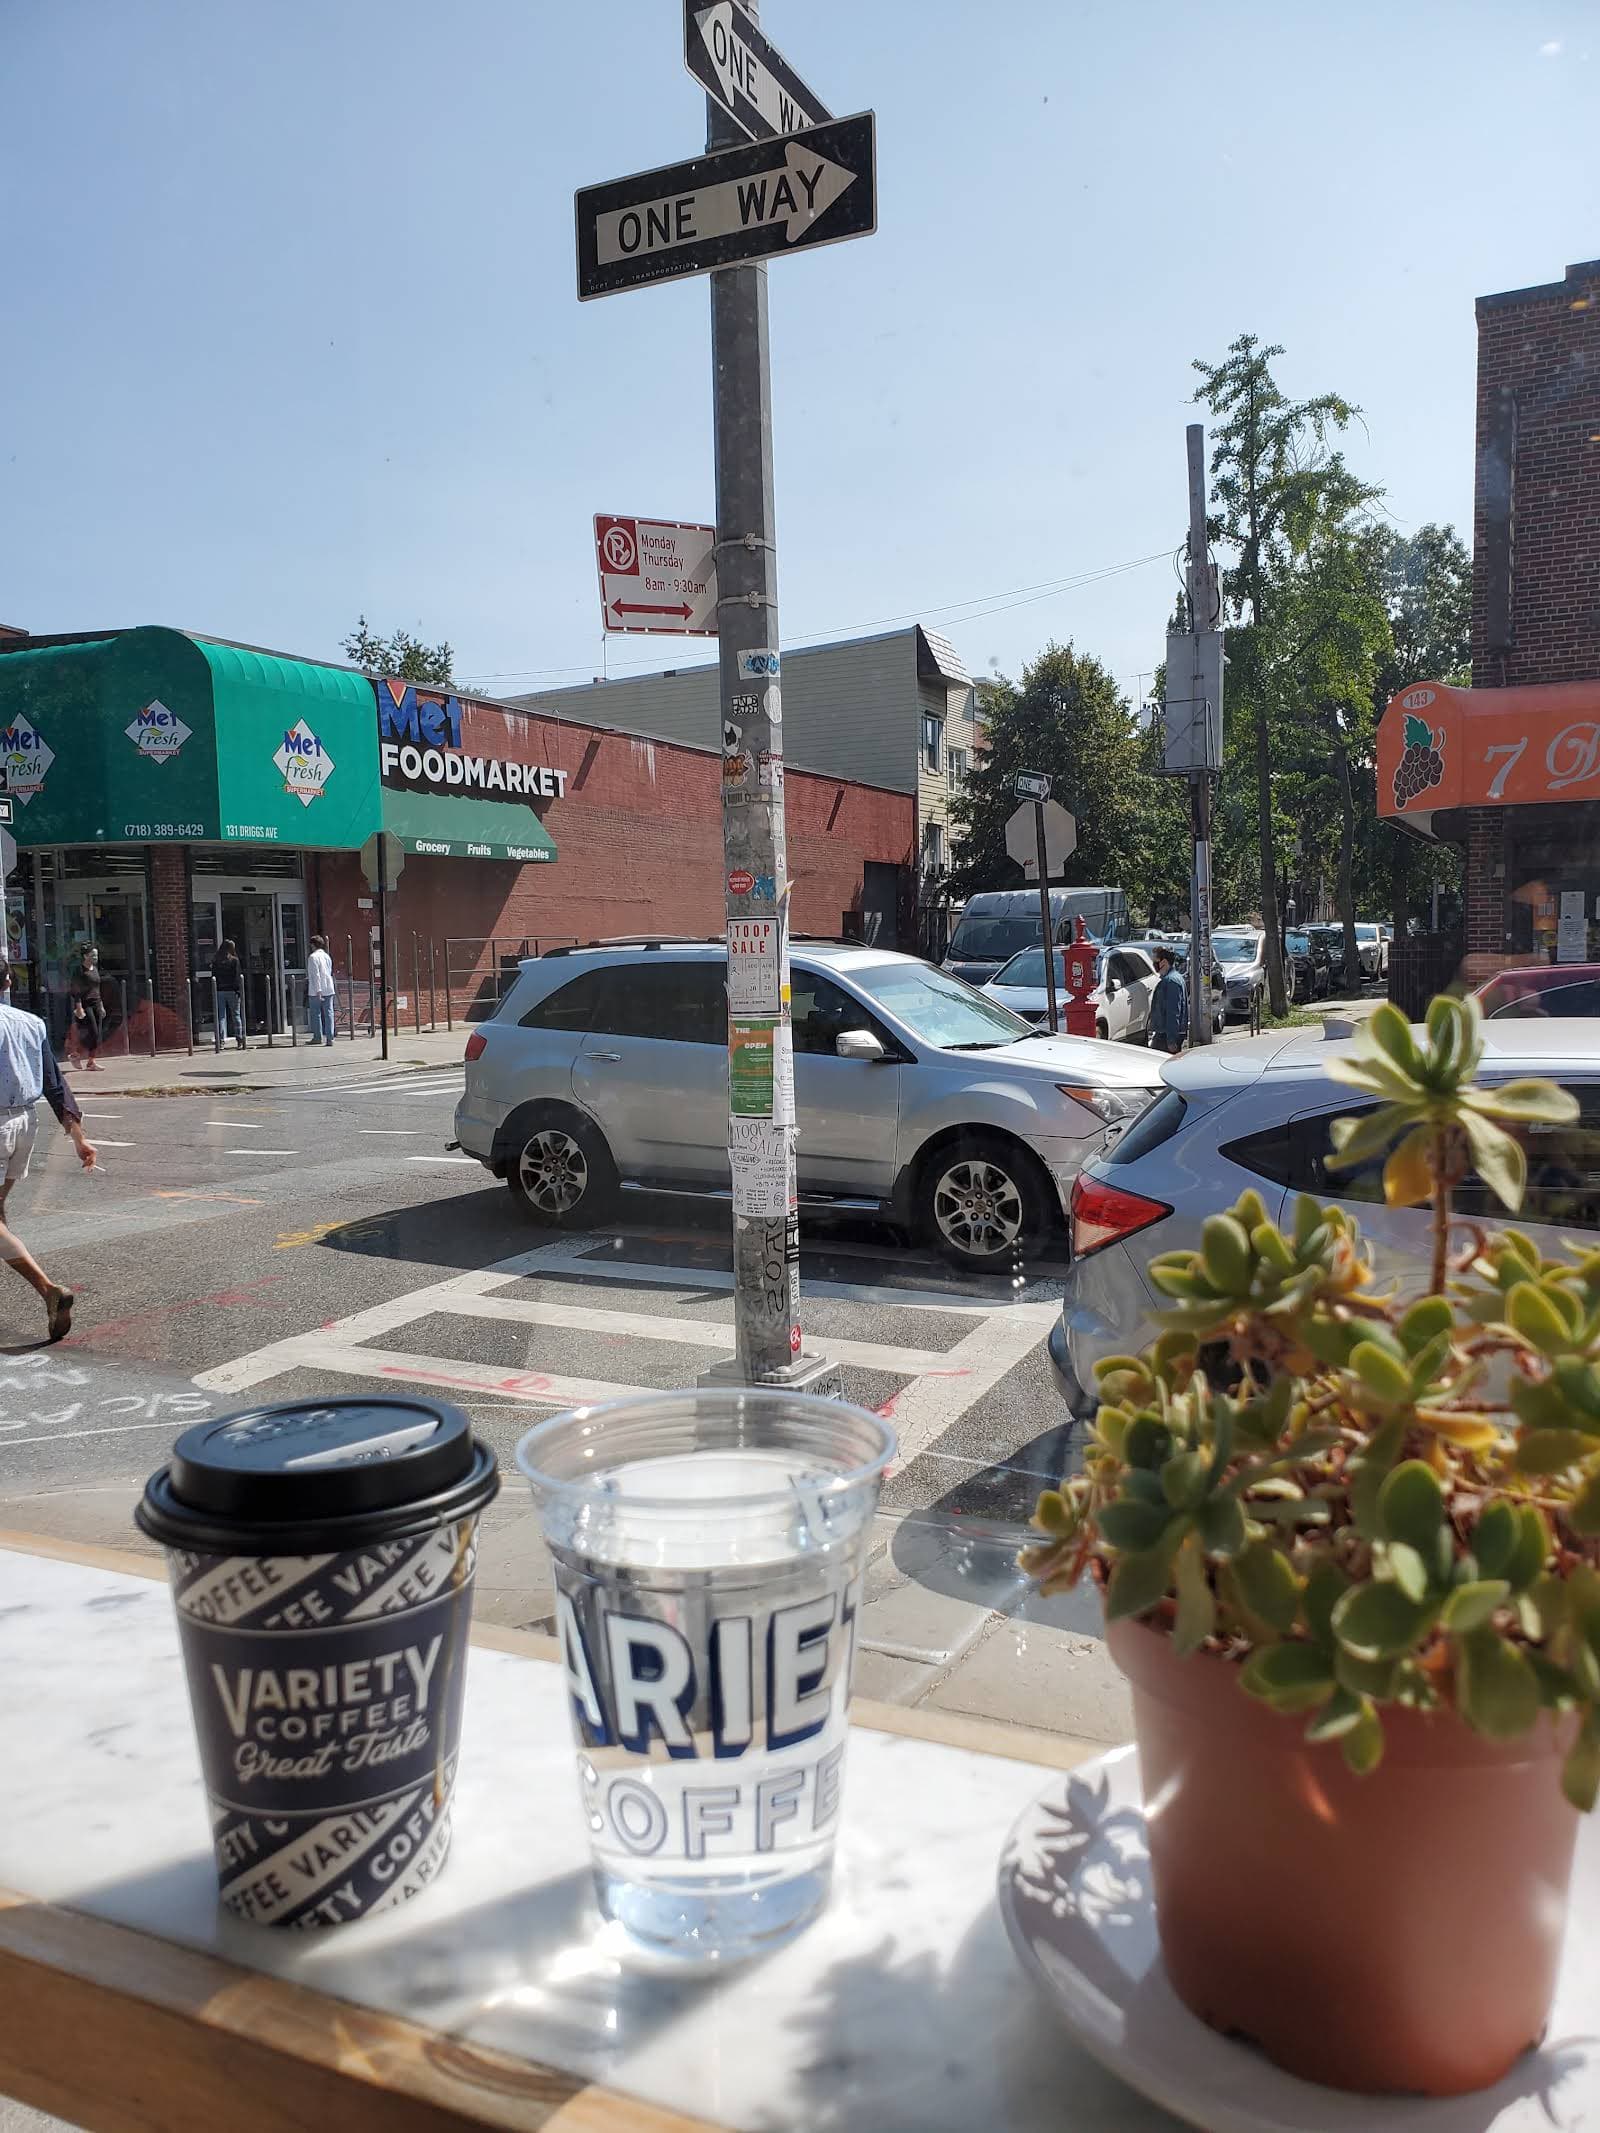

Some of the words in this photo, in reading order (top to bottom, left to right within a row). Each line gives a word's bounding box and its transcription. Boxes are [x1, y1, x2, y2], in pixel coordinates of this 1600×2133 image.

[713, 19, 758, 105] ONE
[618, 196, 698, 254] ONE
[737, 164, 826, 226] WAY
[641, 534, 676, 553] Monday
[643, 551, 685, 571] Thursday
[645, 576, 666, 591] 8am
[674, 579, 707, 595] 9:30am
[137, 707, 178, 726] Met
[377, 679, 464, 749] Met
[2, 727, 40, 753] Met
[137, 727, 179, 746] fresh
[284, 730, 322, 758] Met
[284, 755, 324, 785] fresh
[381, 742, 567, 799] FOODMARKET
[1484, 736, 1529, 799] 7
[286, 786, 324, 796] SUPERMARKET
[1019, 777, 1033, 791] ONE
[125, 824, 152, 837] (718)
[154, 824, 204, 837] 389-6429
[226, 825, 238, 837] 131
[240, 825, 264, 838] DRIGGS
[265, 827, 278, 839] AVE
[415, 840, 451, 856] Grocery
[467, 844, 492, 857] Fruits
[506, 846, 550, 860] Vegetables
[732, 941, 766, 954] SALE
[744, 1042, 768, 1050] OPEN
[211, 1634, 444, 1738] VARIETY
[256, 1694, 412, 1741] COFFEE
[234, 1742, 343, 1785] Great
[342, 1714, 432, 1772] Taste
